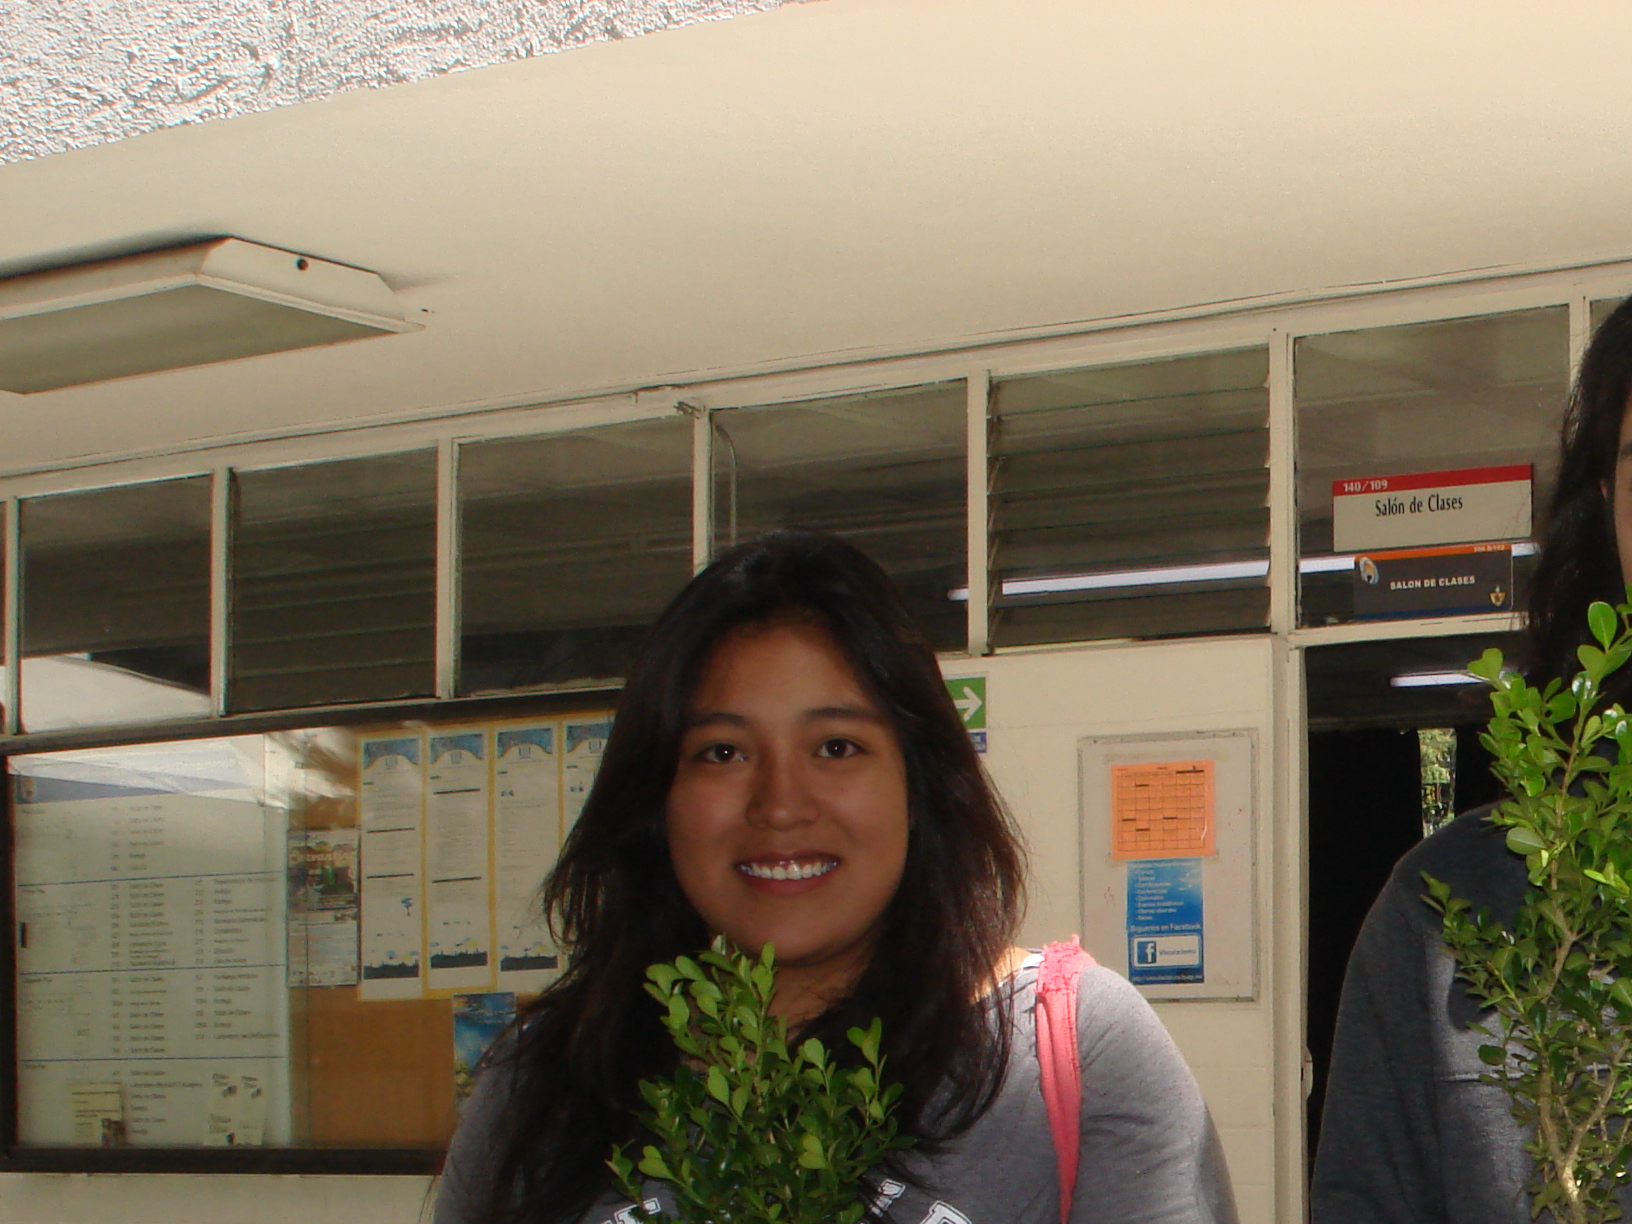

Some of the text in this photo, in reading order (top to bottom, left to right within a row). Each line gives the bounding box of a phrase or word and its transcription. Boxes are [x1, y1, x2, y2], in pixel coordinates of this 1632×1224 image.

[1343, 479, 1388, 492] 140/109
[1375, 493, 1464, 517] Salón de Clases
[1390, 575, 1476, 591] SALON DE CLASES
